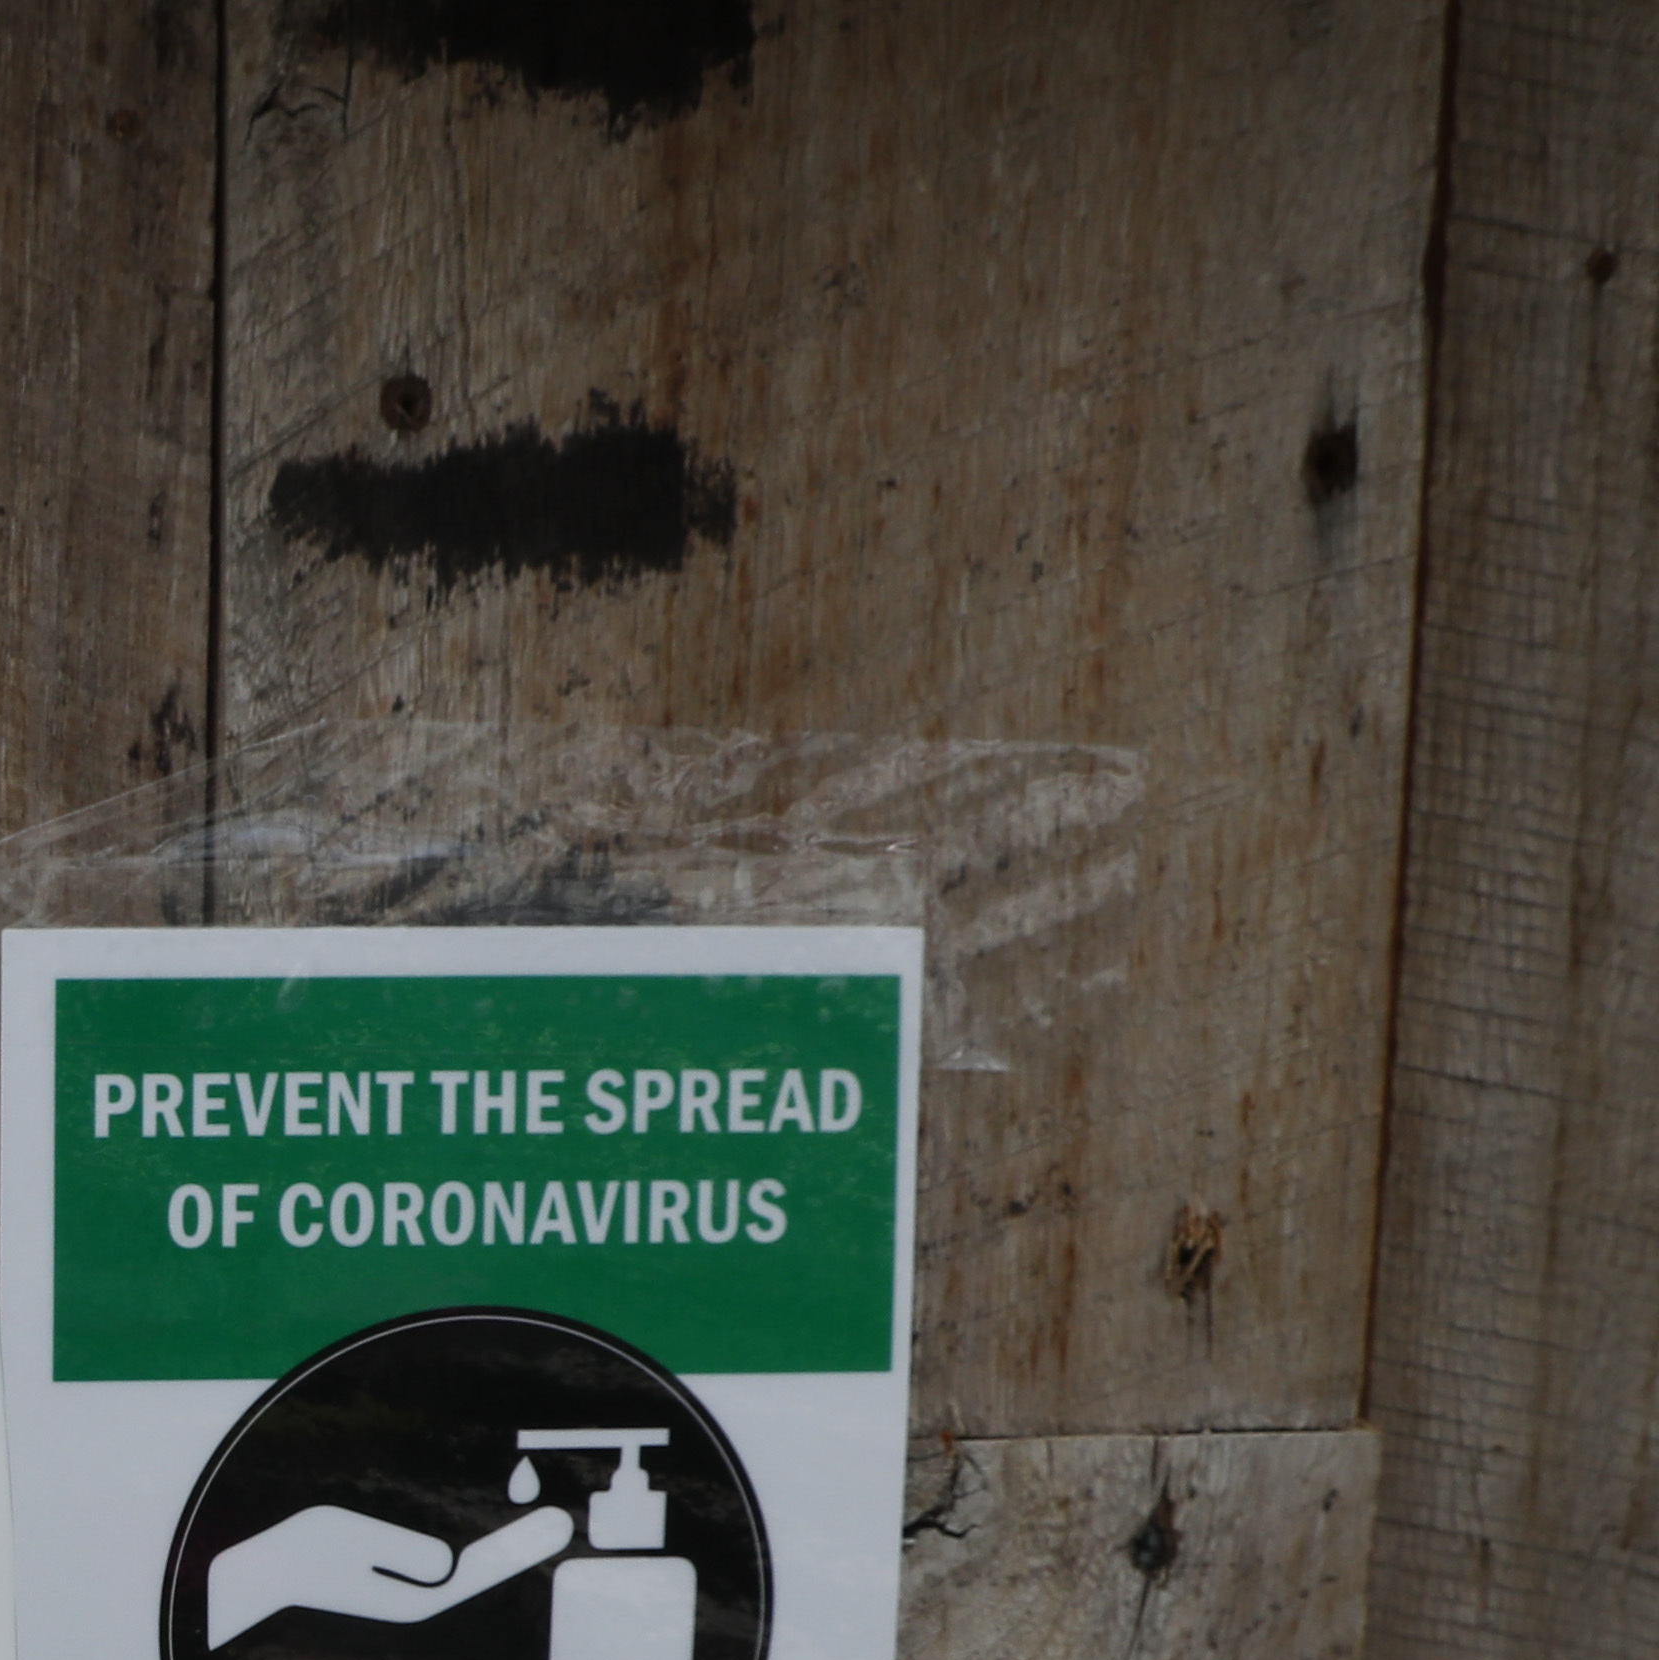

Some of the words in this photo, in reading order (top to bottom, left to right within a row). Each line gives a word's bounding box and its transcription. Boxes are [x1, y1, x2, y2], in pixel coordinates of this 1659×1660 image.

[94, 1070, 415, 1138] PREVENT
[430, 1069, 566, 1135] THE
[584, 1068, 863, 1135] SPREAD
[167, 1183, 260, 1249] OF
[278, 1178, 788, 1248] CORONAVIRUS
